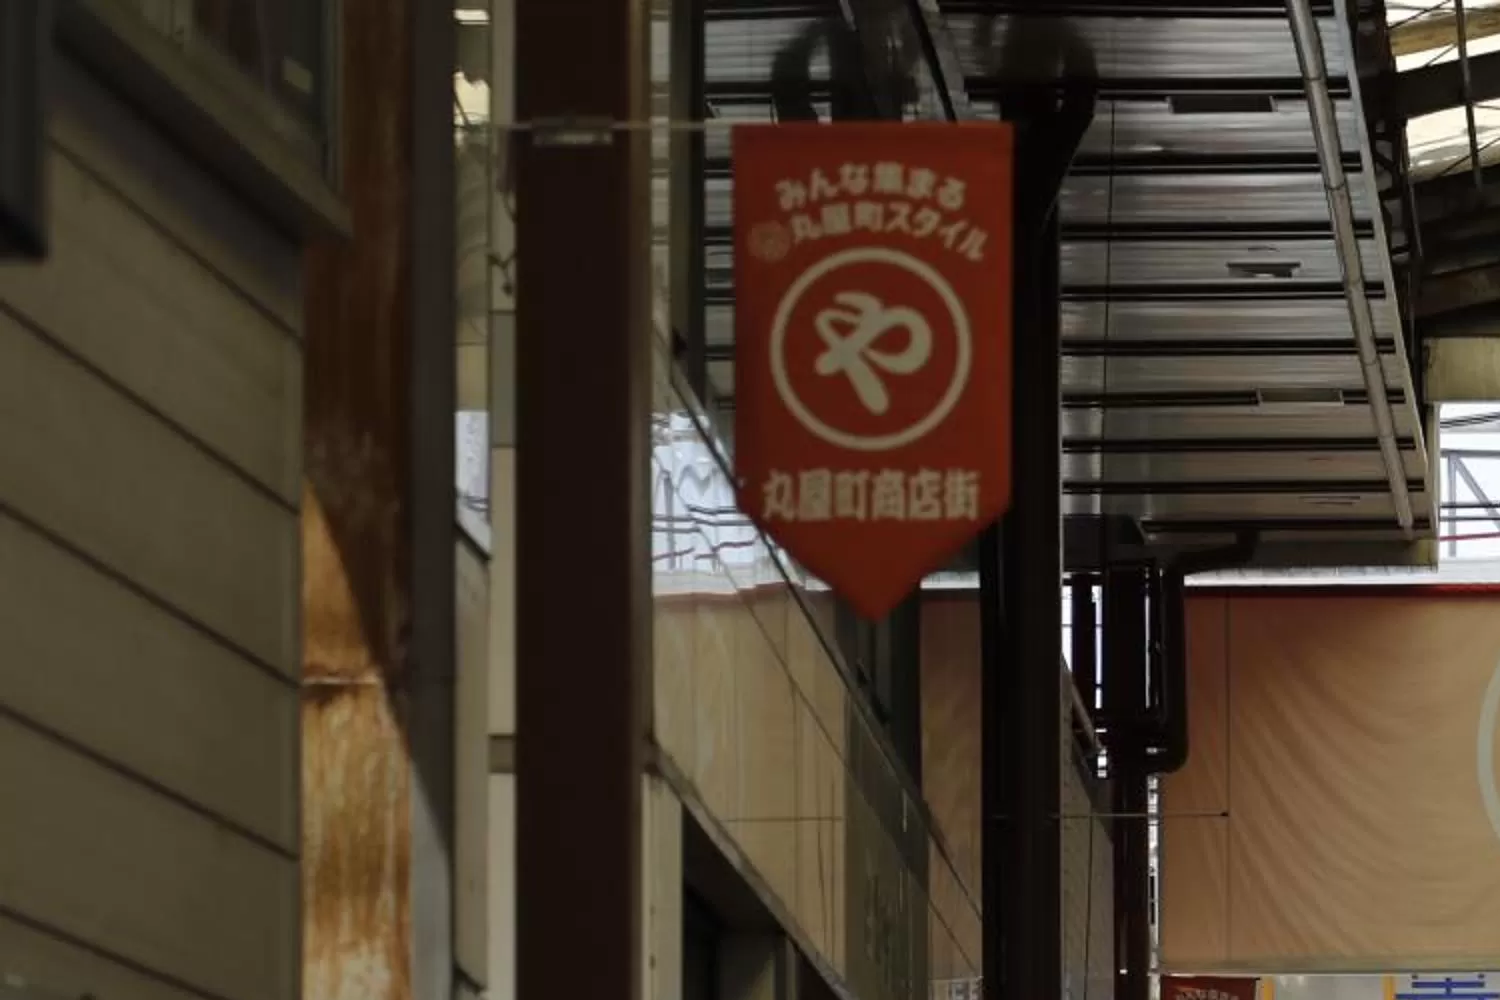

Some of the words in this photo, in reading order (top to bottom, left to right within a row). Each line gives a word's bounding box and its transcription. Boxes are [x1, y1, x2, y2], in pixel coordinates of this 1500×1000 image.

[763, 467, 980, 521] 丸屋町商店街
